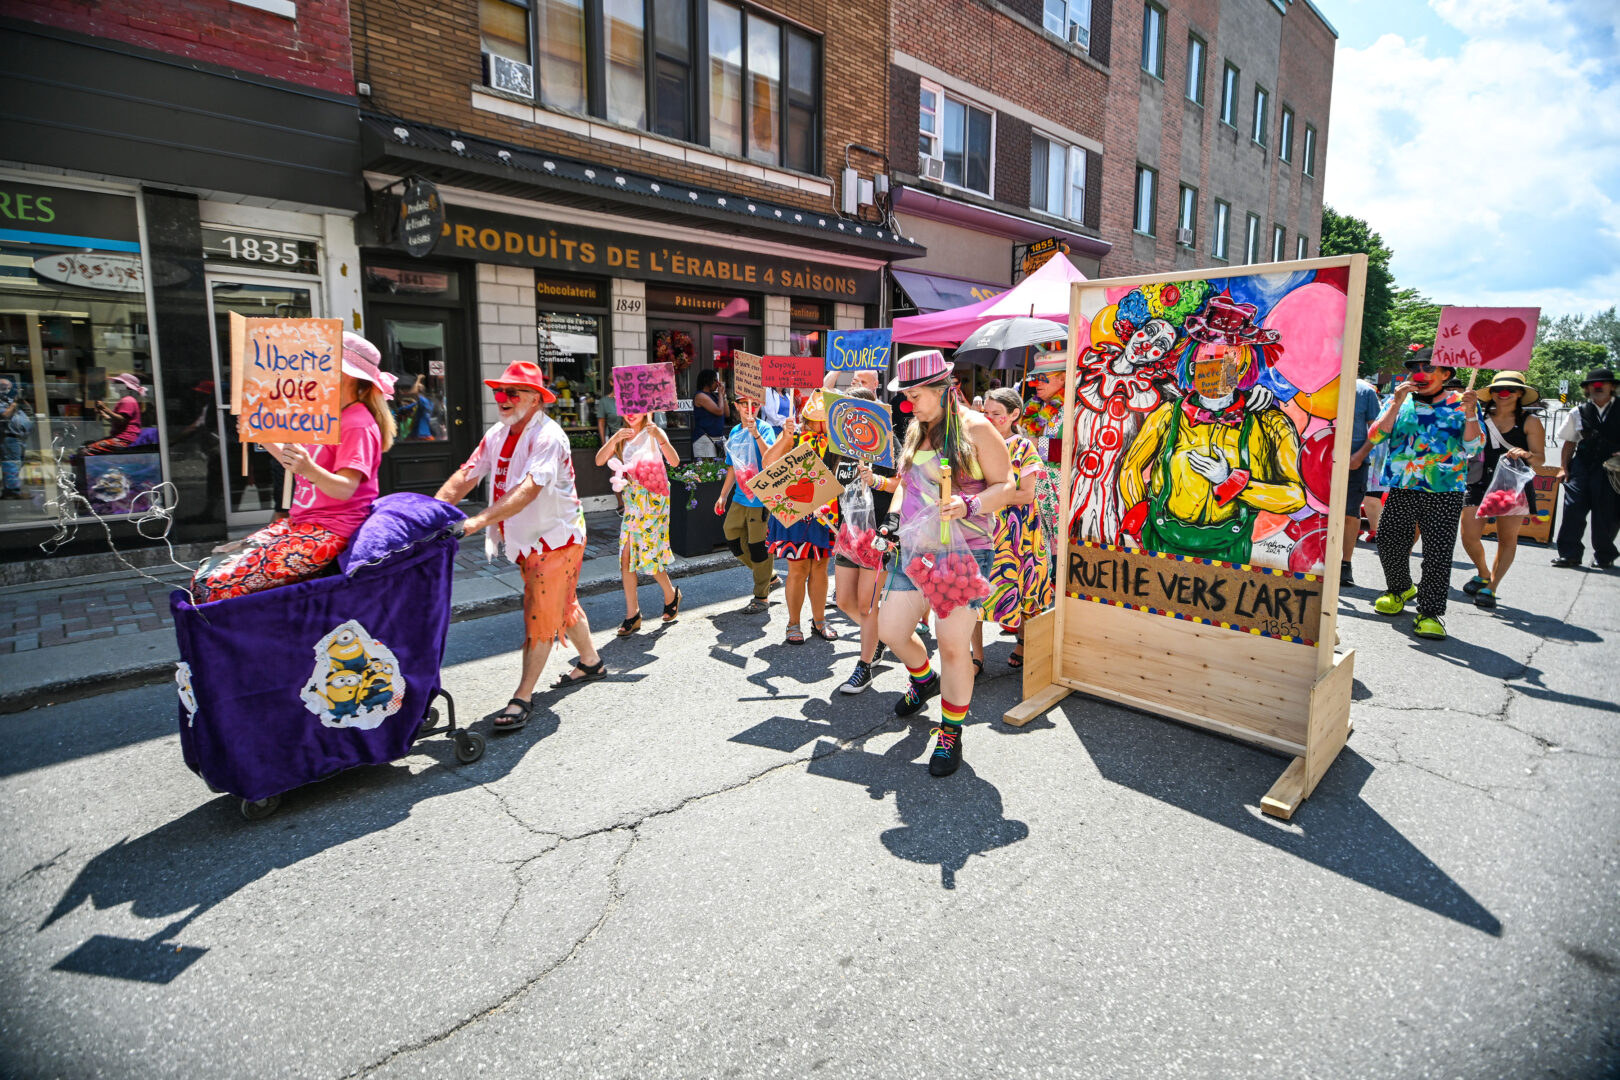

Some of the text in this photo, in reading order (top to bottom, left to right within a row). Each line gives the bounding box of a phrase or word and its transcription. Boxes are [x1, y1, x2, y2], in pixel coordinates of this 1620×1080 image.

[222, 236, 299, 264] 1835
[1031, 238, 1054, 252] 1855
[607, 246, 640, 269] DE
[650, 249, 756, 283] L'ÉRABLE
[763, 268, 774, 285] 4
[781, 267, 857, 295] SAISONS
[537, 282, 597, 298] Chocolaterie
[616, 298, 641, 312] 1849
[675, 295, 726, 310] Pâtisserie
[1442, 323, 1461, 339] JE
[253, 335, 332, 371] Liberté
[269, 372, 317, 401] joie
[249, 402, 338, 435] douceur
[838, 402, 868, 424] Fais
[844, 423, 868, 436] Moi
[753, 480, 769, 490] Tu
[772, 474, 791, 488] mon
[1157, 571, 1229, 612] VERS
[1234, 579, 1319, 625] L'ART
[1262, 620, 1301, 638] 1855
